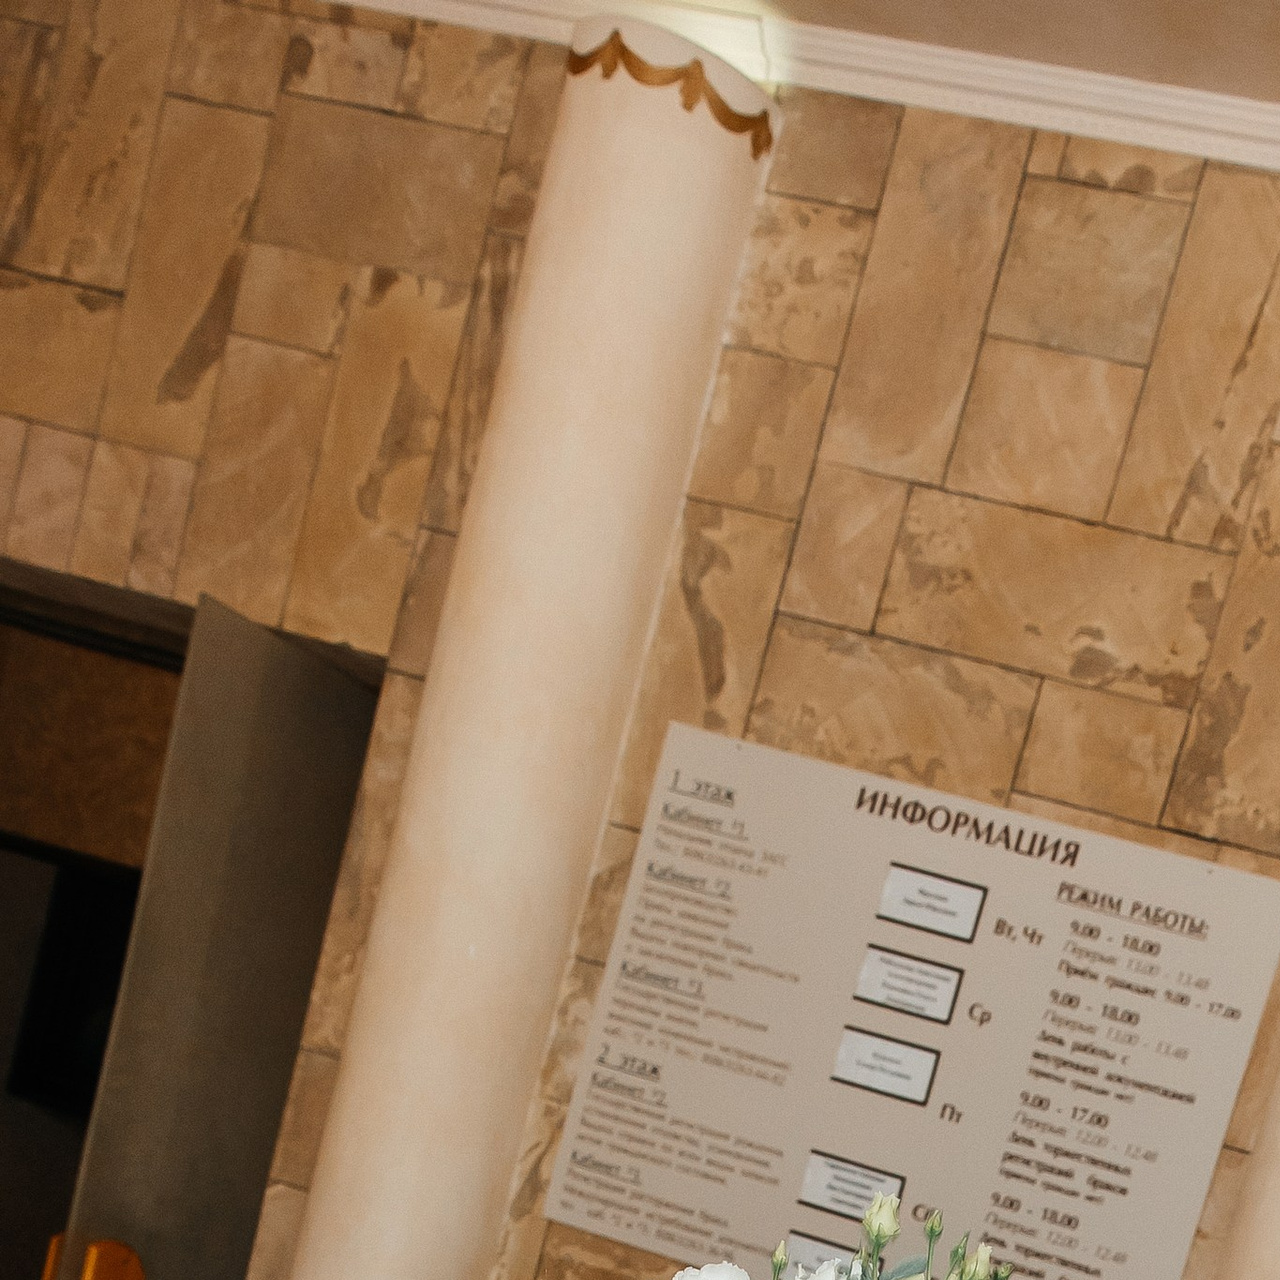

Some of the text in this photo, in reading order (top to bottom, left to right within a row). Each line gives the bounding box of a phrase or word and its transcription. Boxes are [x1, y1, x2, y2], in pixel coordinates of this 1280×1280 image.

[854, 784, 1082, 869] ИНФОРМАЦИЯ
[1055, 880, 1210, 939] РЕЖИМ РАБОТЫ:
[991, 918, 1045, 946] Вт, Чт
[1067, 919, 1101, 940] 9.00
[1047, 988, 1080, 1009] 9.00
[966, 1002, 993, 1028] Ср
[596, 1042, 611, 1064] 2
[938, 1101, 964, 1124] Пт
[1017, 1090, 1051, 1112] 9.00
[1069, 1105, 1110, 1129] 17.00
[988, 1191, 1021, 1213] 9.00
